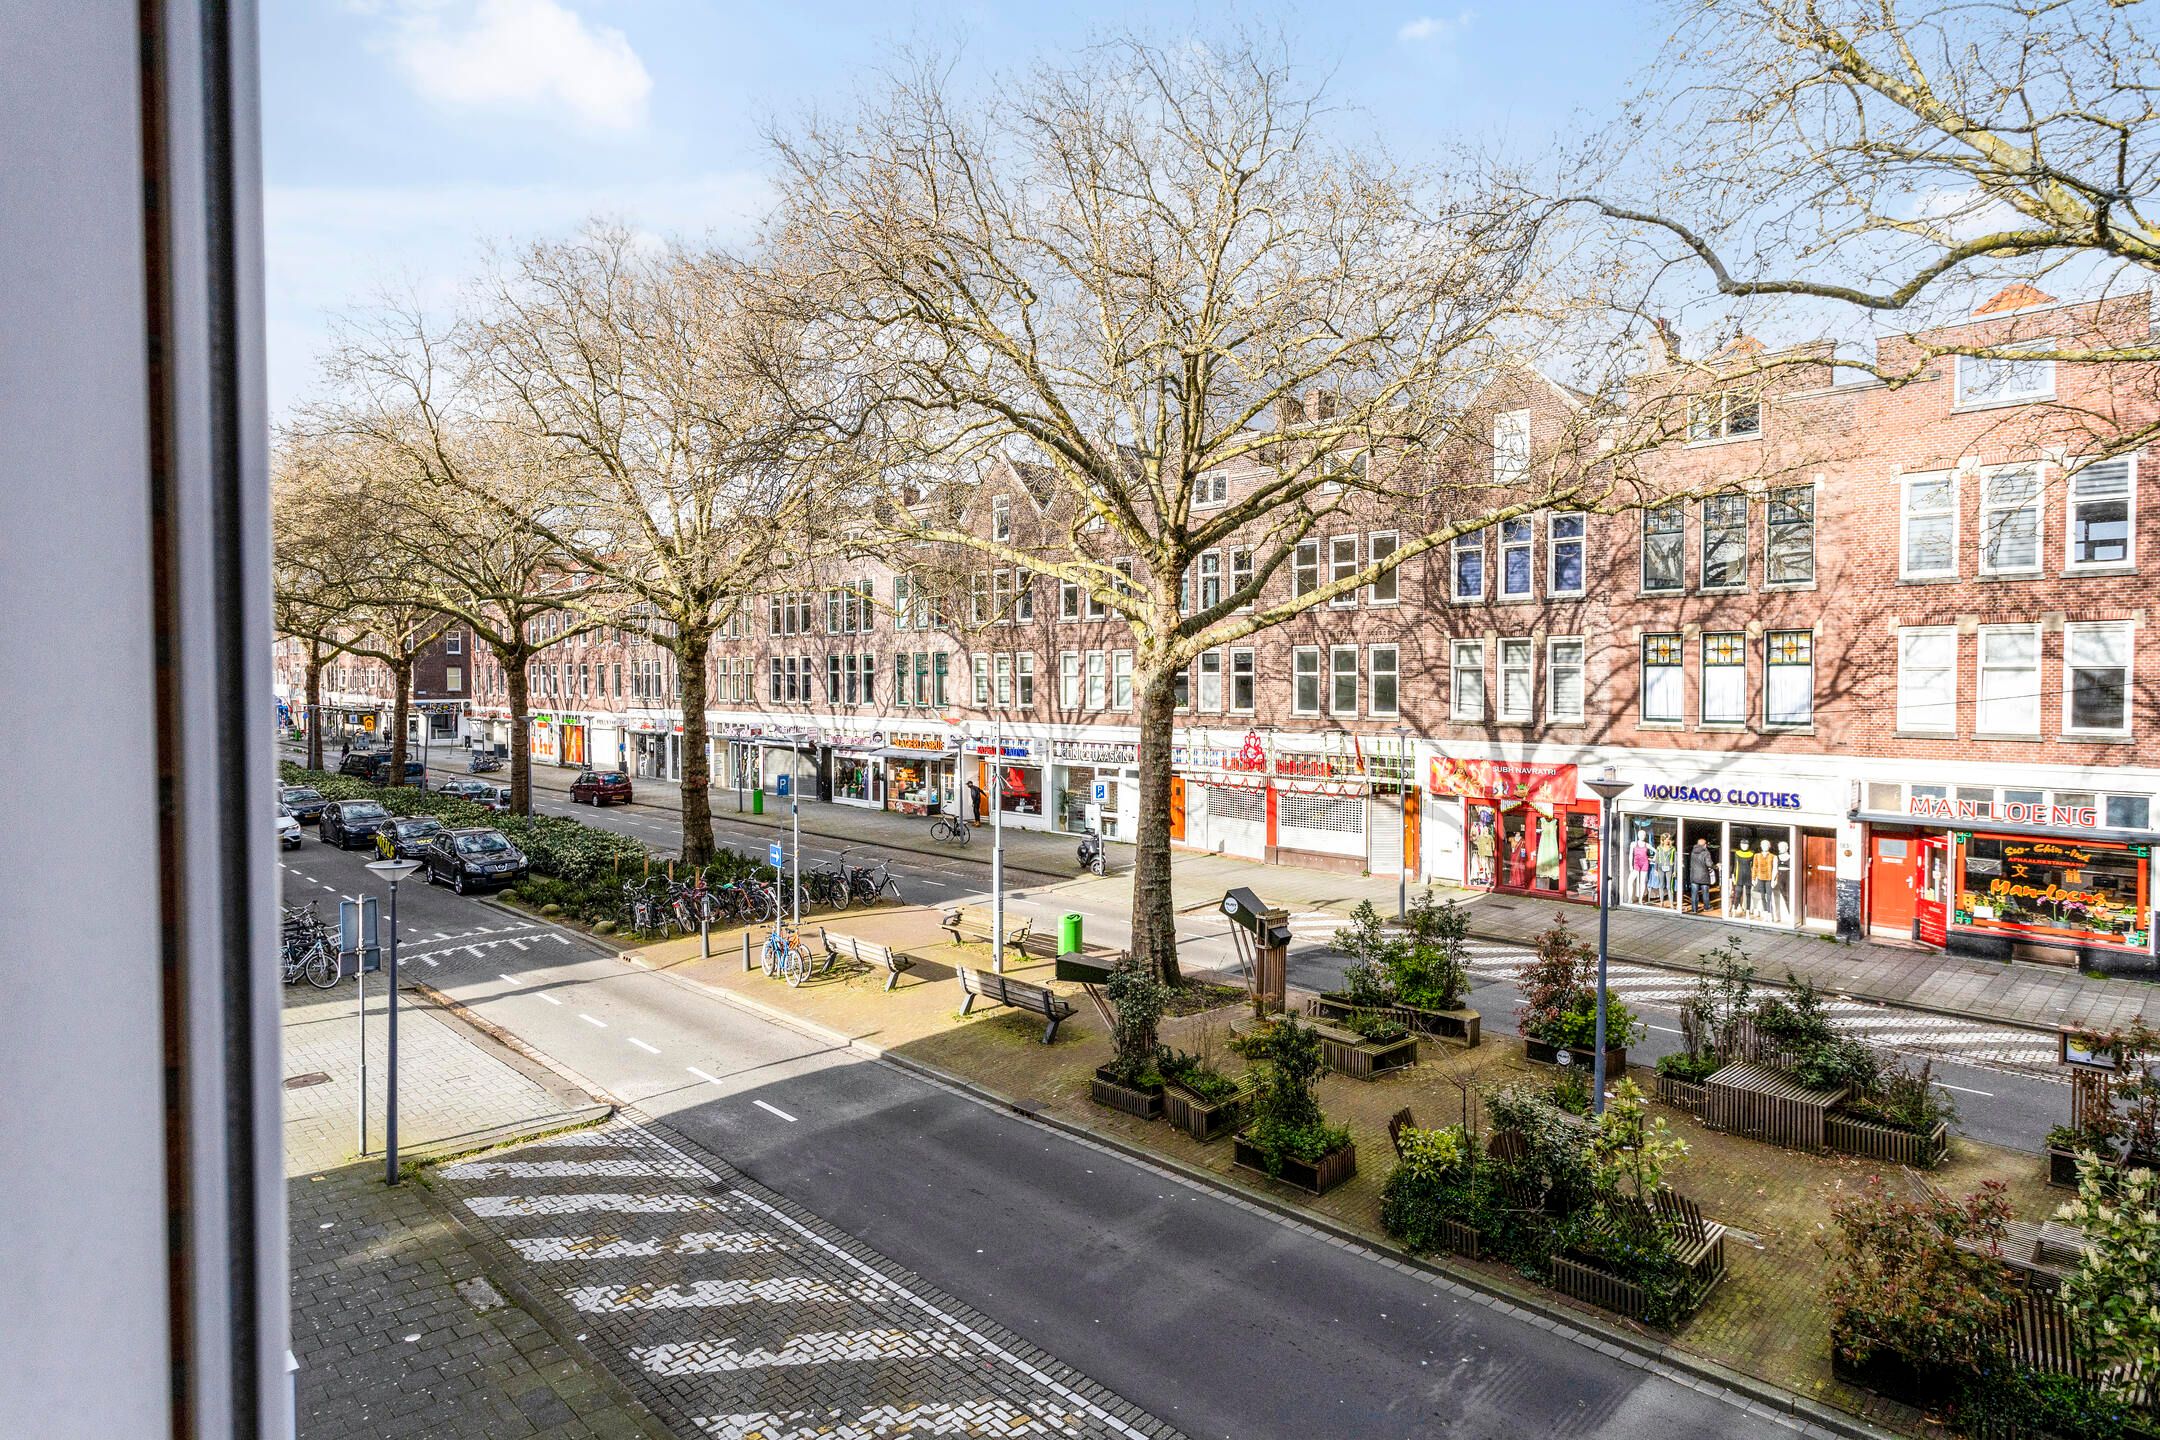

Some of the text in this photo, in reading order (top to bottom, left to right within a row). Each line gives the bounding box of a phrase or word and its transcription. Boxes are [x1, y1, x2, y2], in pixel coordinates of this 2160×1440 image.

[1492, 766, 1556, 776] SUBH NAVRATRI
[780, 779, 786, 790] P
[1643, 783, 1802, 810] MOUSACO CLOTHES
[1909, 796, 2098, 828] MAN LOENG
